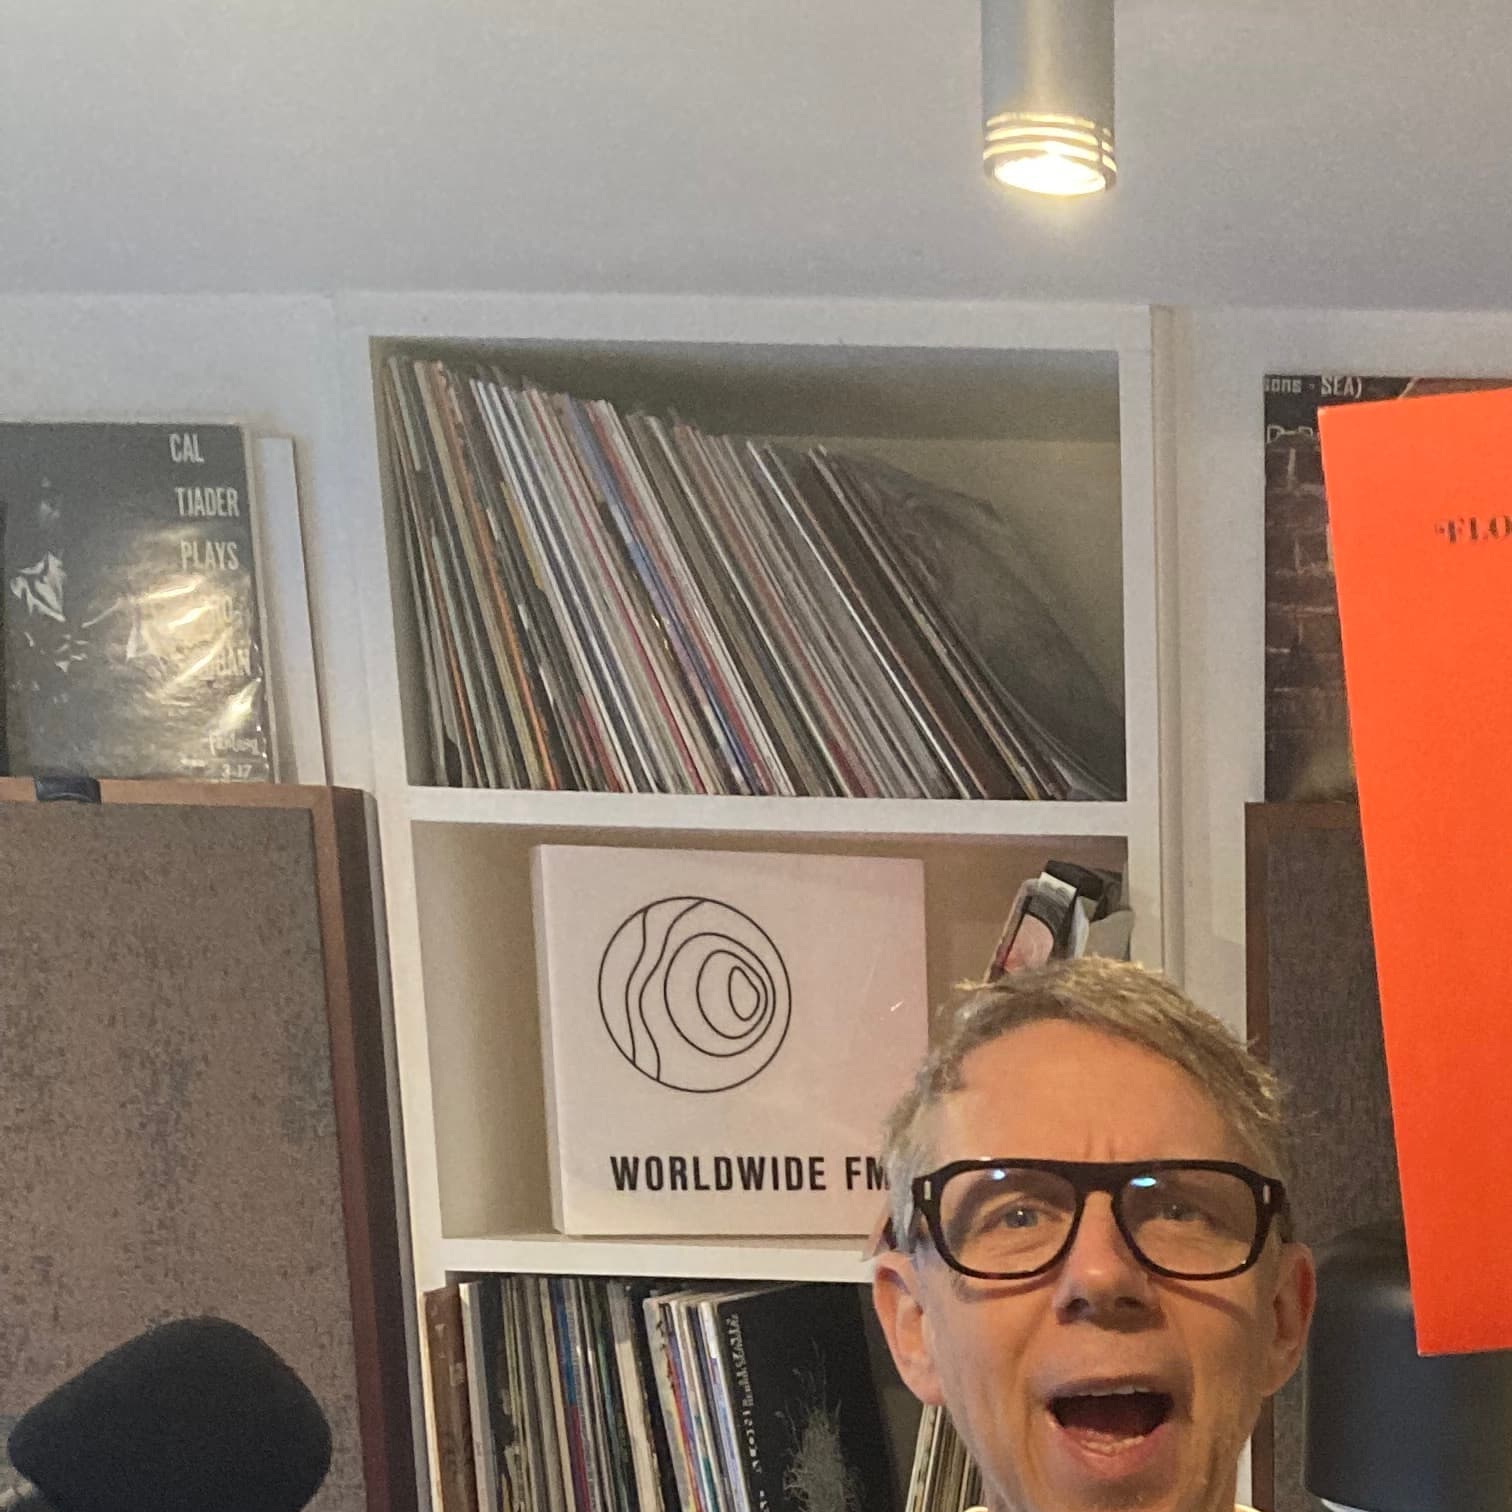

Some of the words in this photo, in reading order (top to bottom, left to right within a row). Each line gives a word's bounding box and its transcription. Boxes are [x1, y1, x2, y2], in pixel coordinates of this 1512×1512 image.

[169, 433, 204, 462] CAL
[180, 540, 239, 572] PLAYS
[610, 1156, 827, 1191] WORLDWIDE
[845, 1157, 889, 1190] FM
